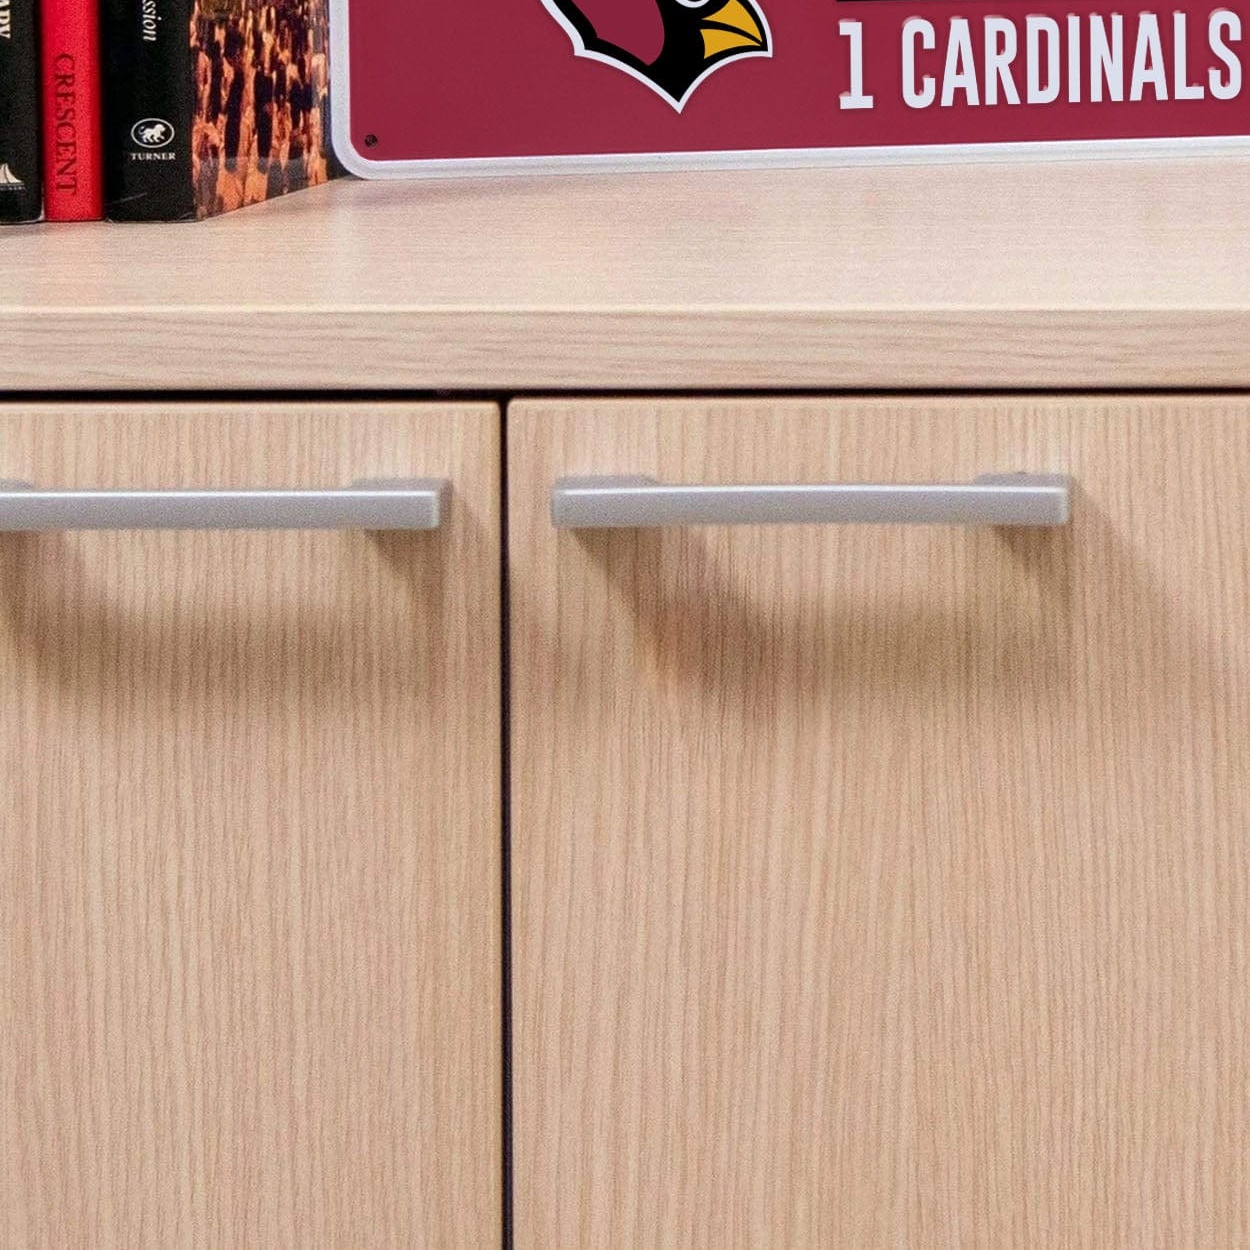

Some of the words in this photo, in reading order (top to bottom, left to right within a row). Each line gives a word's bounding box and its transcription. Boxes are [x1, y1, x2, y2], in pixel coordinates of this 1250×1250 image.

[838, 19, 874, 110] 1
[901, 8, 1242, 109] CARDINALS
[55, 52, 78, 196] CRESCENT
[130, 152, 176, 161] TURNER
